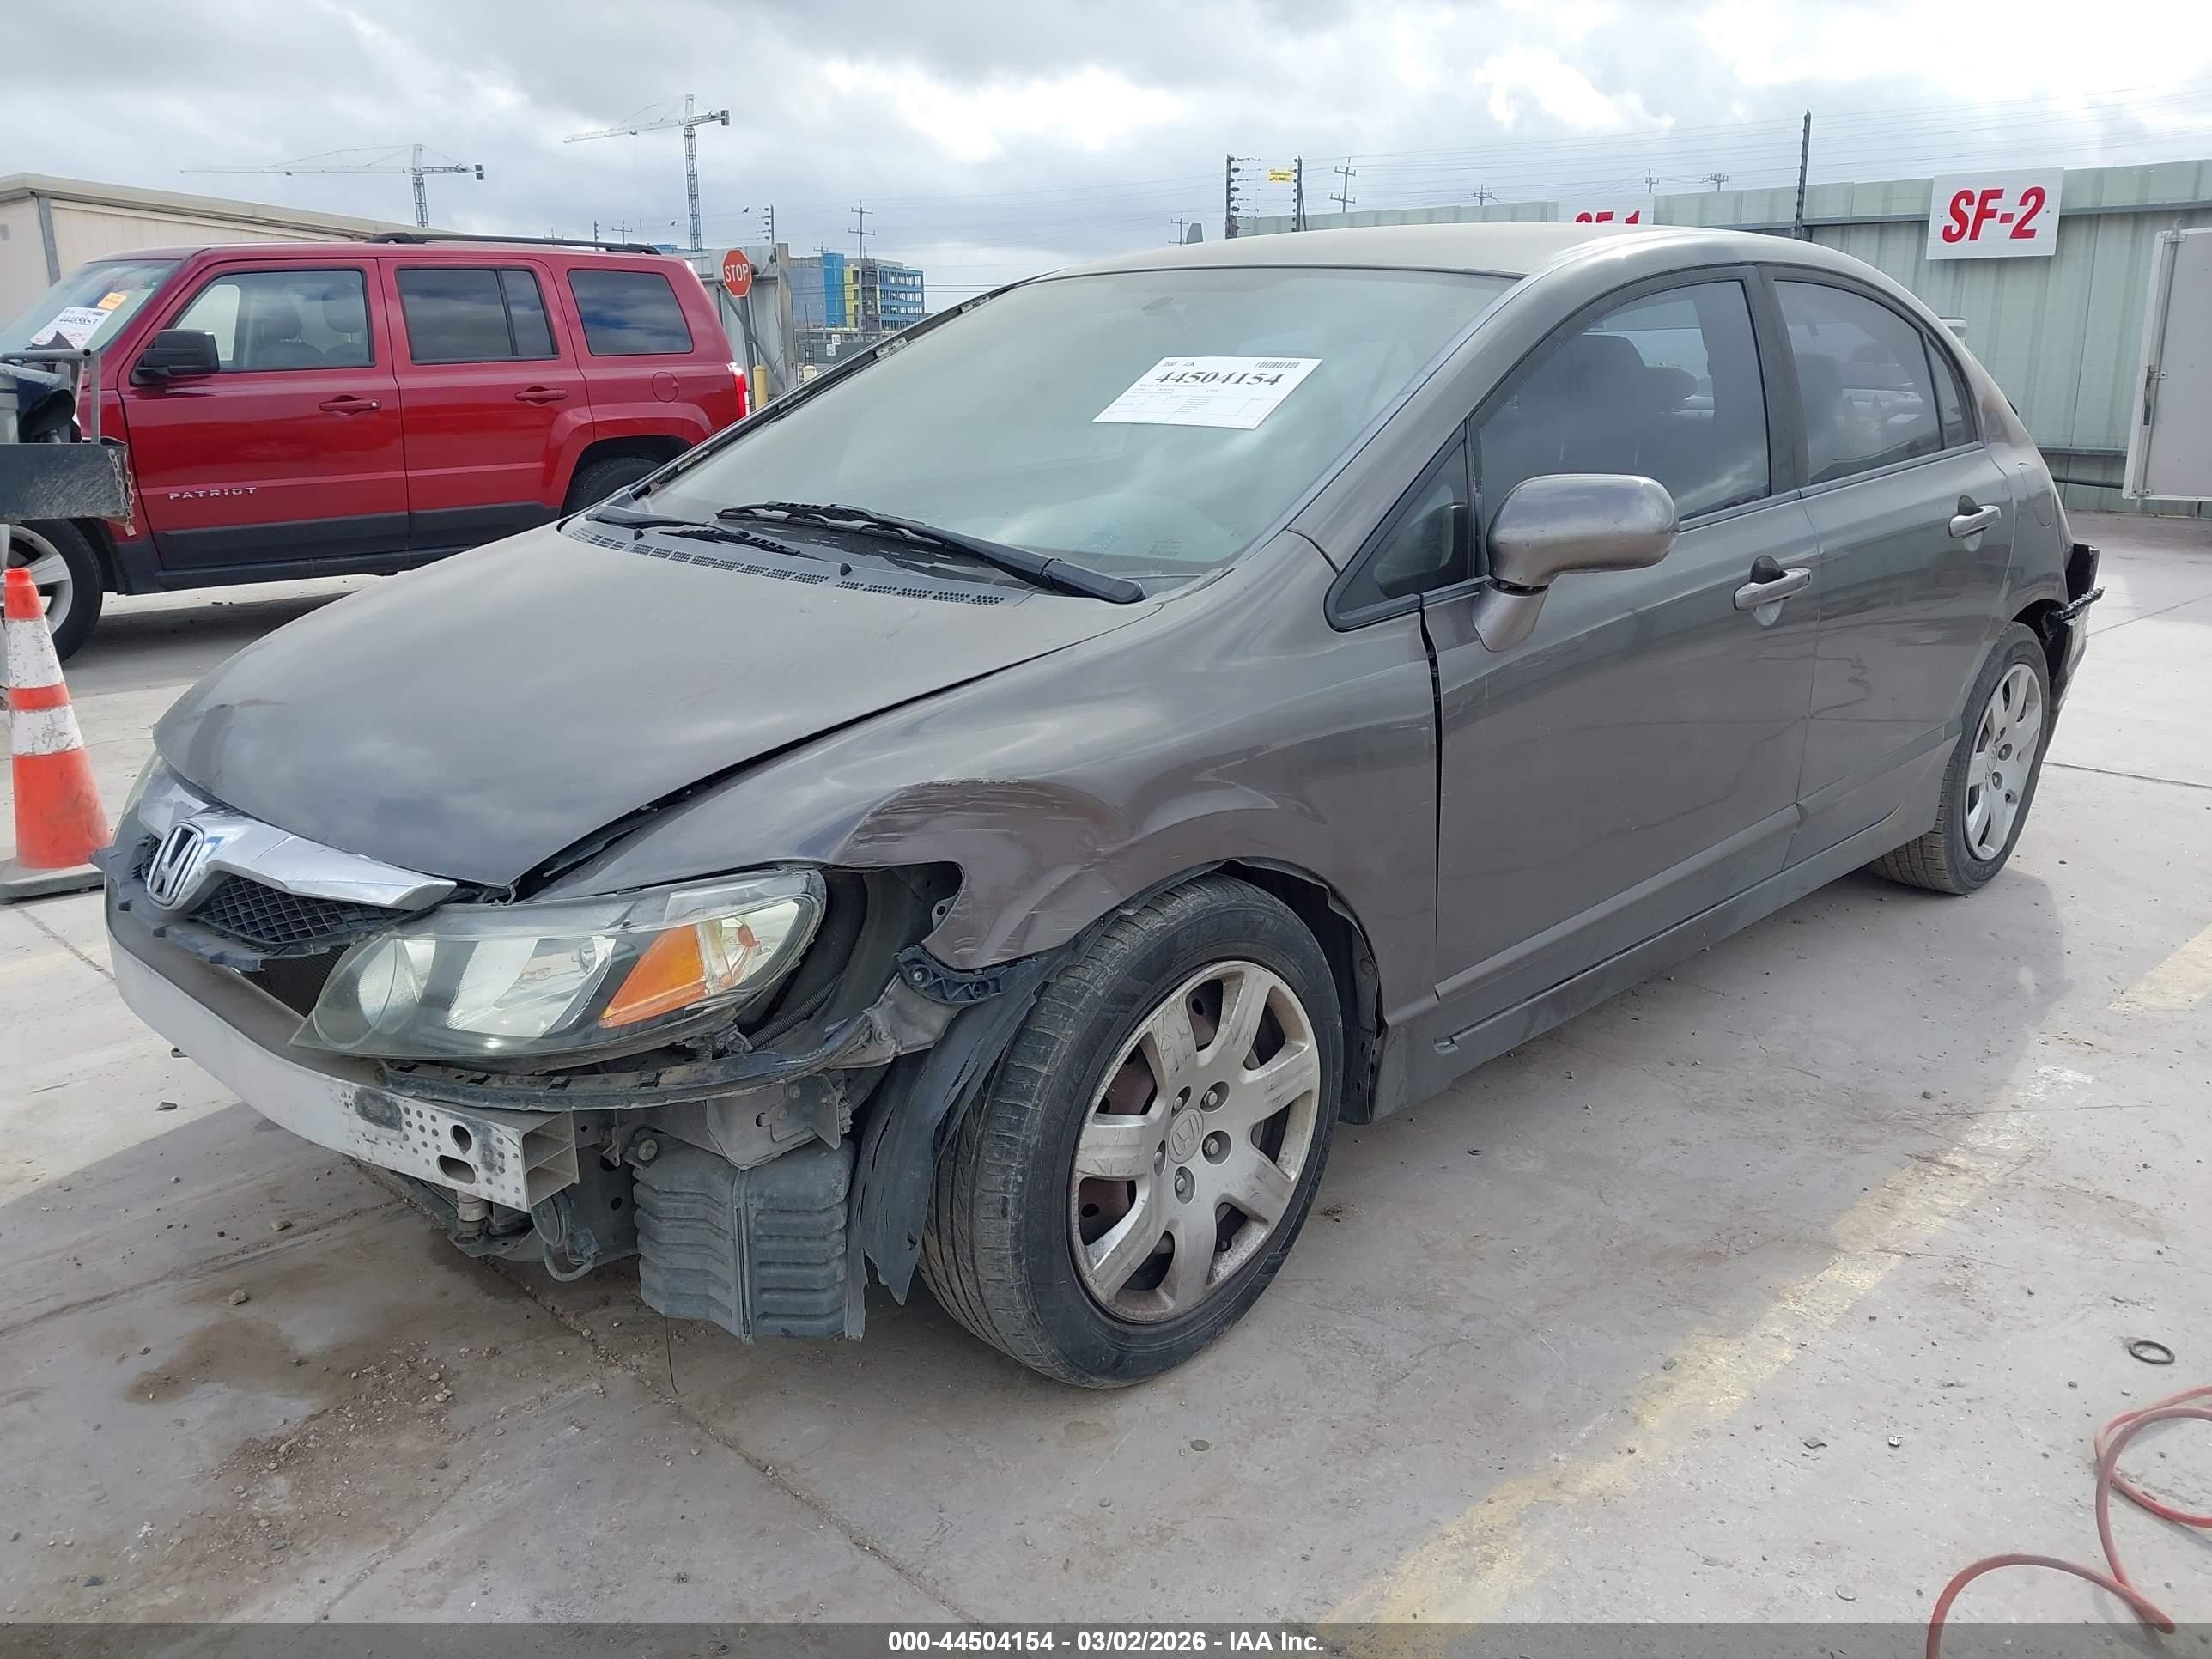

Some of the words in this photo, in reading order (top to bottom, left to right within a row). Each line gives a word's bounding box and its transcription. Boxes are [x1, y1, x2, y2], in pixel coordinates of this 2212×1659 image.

[1942, 186, 2046, 243] SF-2
[724, 264, 749, 283] STOP
[1155, 370, 1285, 386] 44504154
[168, 487, 257, 500] PATRIOT
